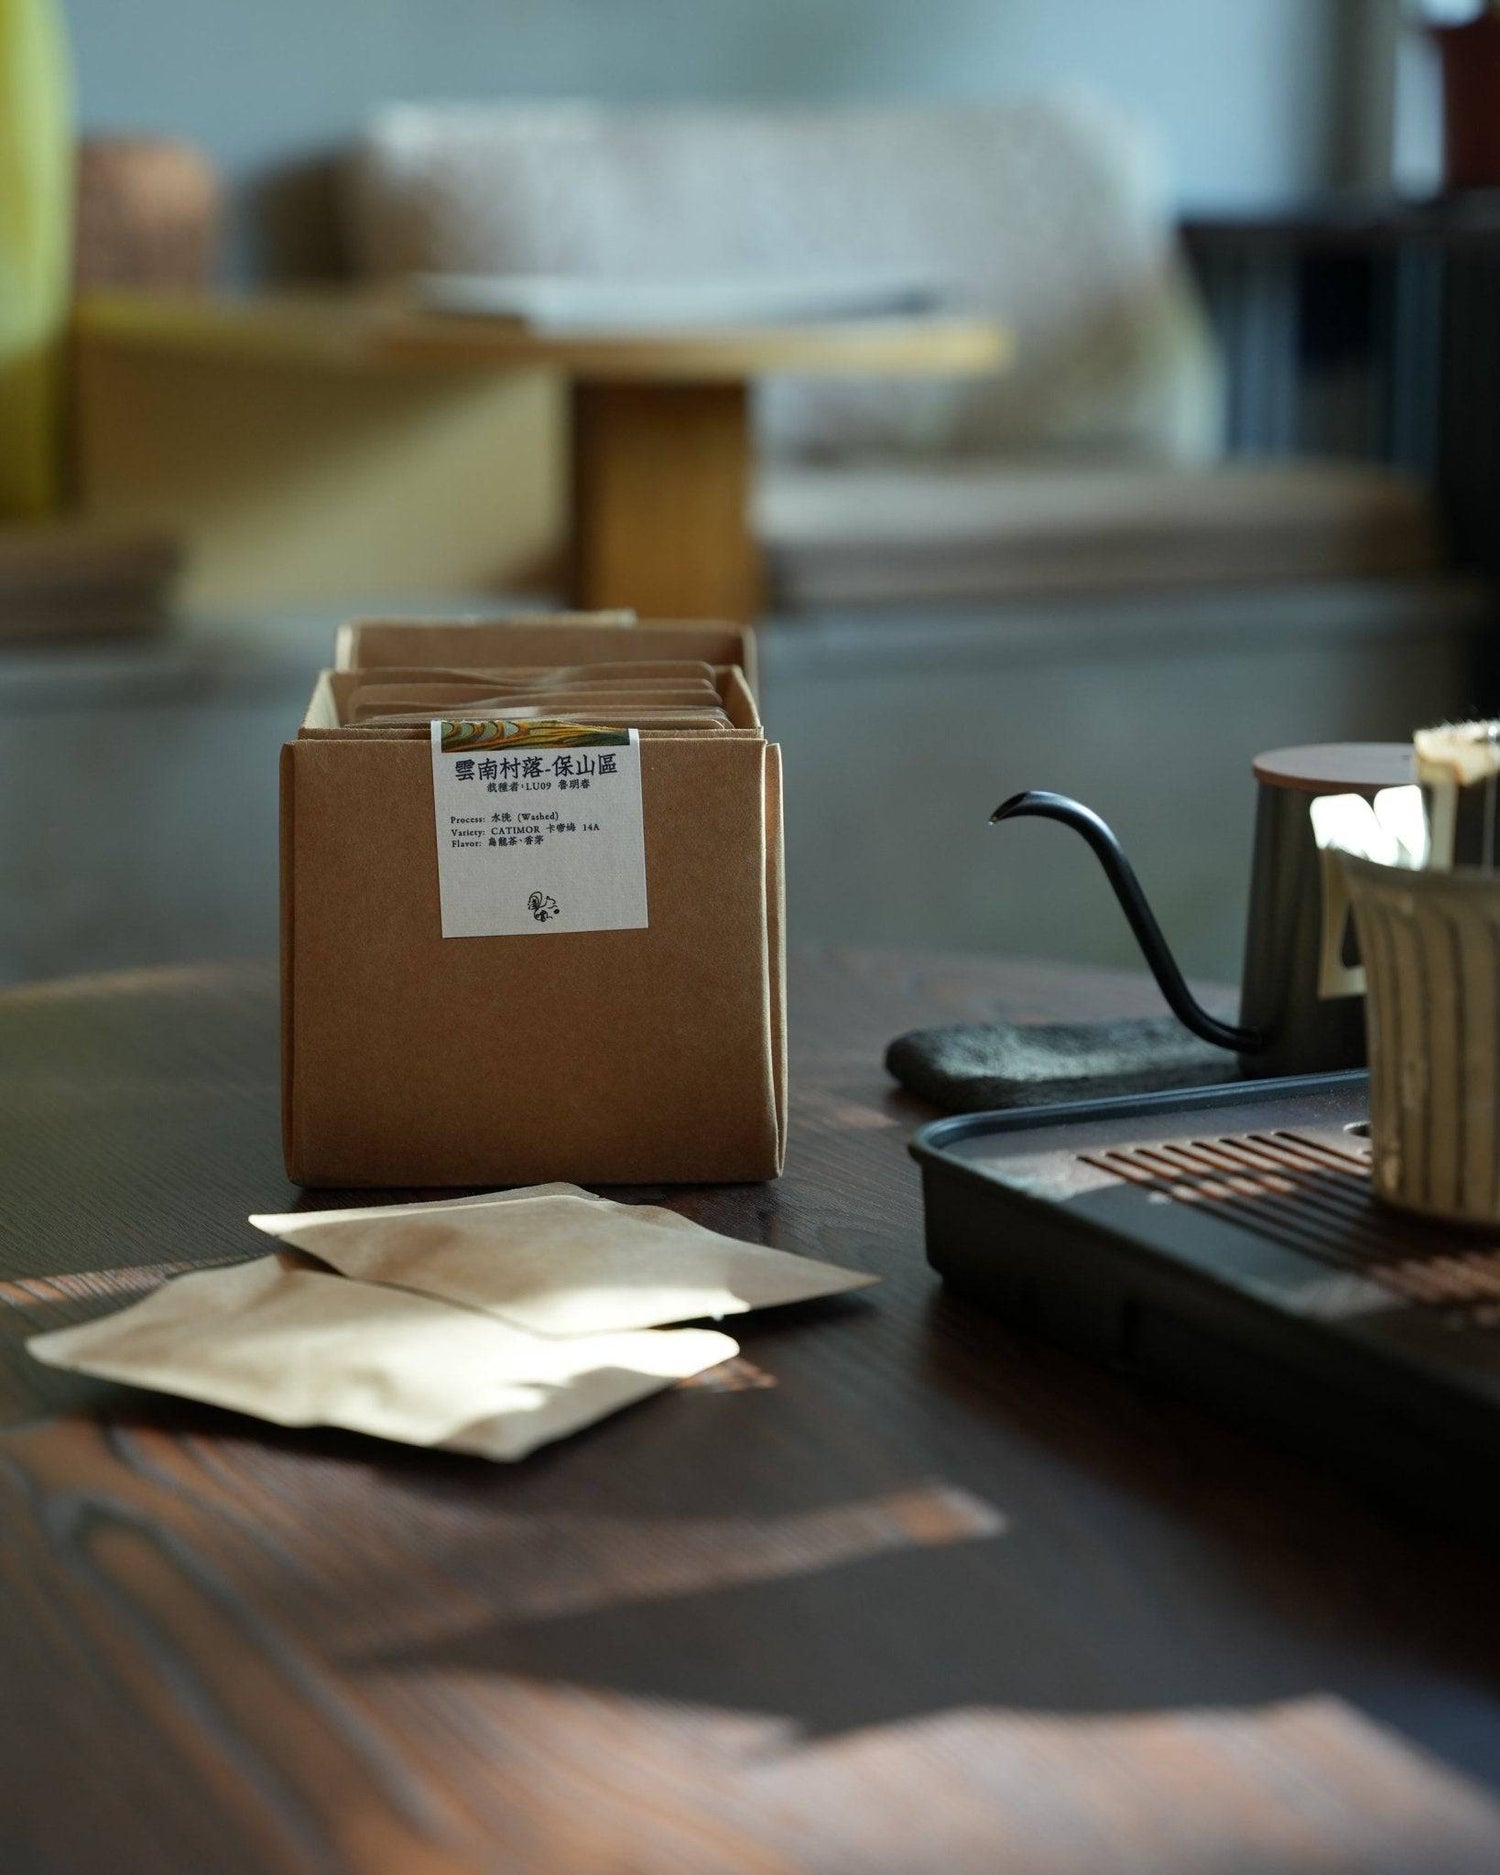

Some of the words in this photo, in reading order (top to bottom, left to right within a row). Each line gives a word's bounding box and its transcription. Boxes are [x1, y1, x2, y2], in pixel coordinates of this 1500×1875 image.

[455, 753, 618, 781] 雲南村落-保山區
[450, 815, 486, 824] Process:
[491, 812, 512, 823] 水洗
[517, 811, 559, 823] (Washed)
[451, 828, 486, 838] Variety:
[490, 825, 540, 835] CATIMOR
[583, 823, 600, 832] 14A
[451, 839, 482, 848] Flavor:
